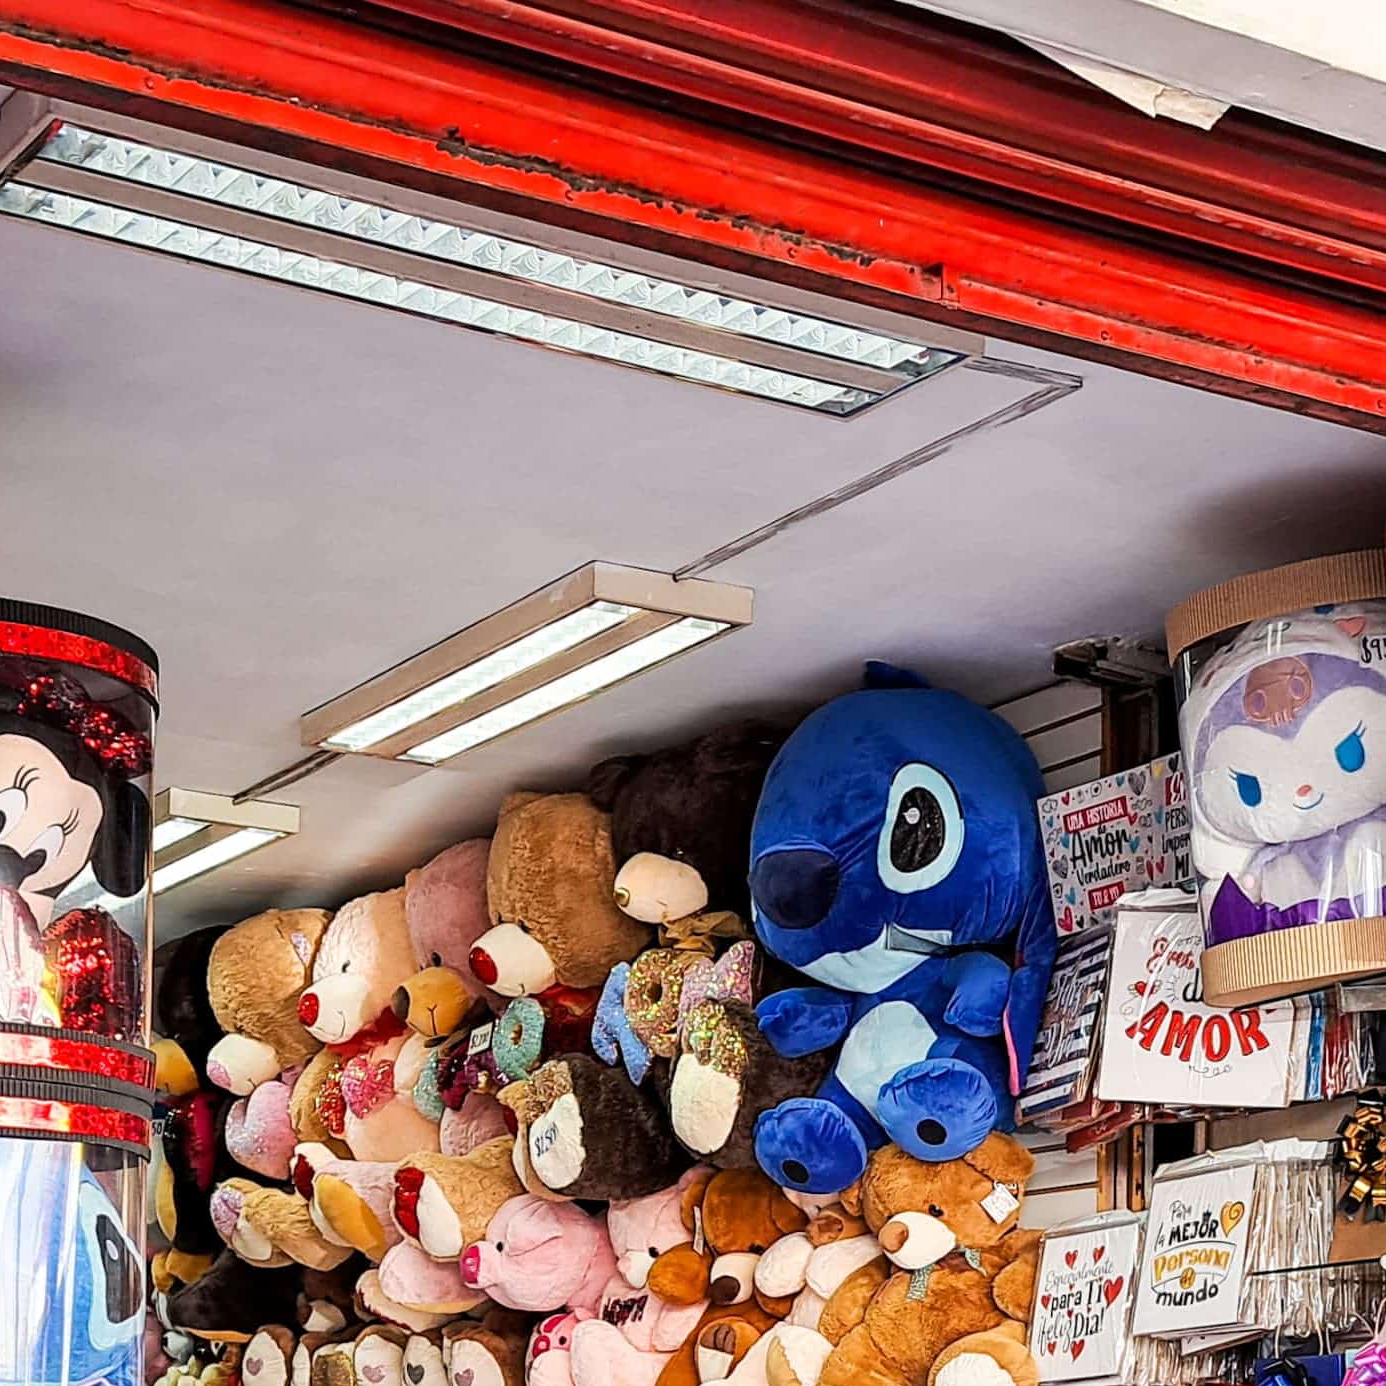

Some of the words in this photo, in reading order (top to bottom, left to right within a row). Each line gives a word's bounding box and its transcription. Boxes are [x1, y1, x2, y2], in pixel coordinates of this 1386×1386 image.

[1070, 828, 1132, 870] Amor
[1124, 1000, 1271, 1064] AMOR
[1168, 1218, 1220, 1247] MEJOR
[1050, 1290, 1083, 1318] para
[1155, 1276, 1219, 1307] mundo
